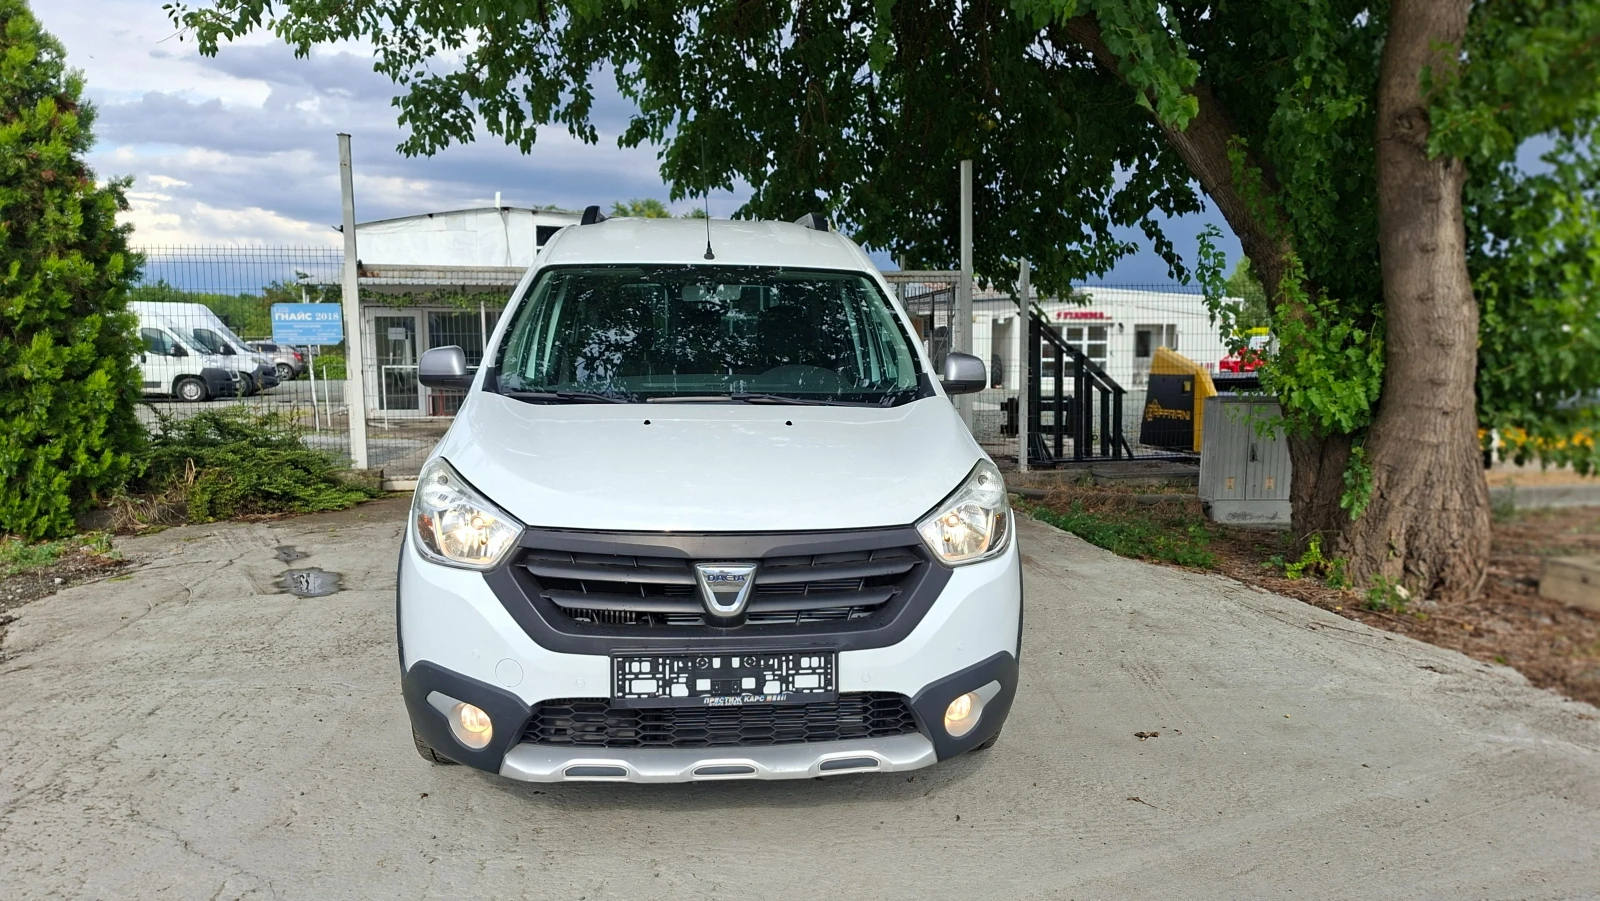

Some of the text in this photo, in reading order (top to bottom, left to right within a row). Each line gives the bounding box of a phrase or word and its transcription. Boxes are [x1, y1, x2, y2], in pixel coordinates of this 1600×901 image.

[275, 311, 339, 321] ГНАЙС 2018
[707, 574, 746, 582] DACIA
[703, 695, 765, 704] ПРЕСТИЖ КАРС
